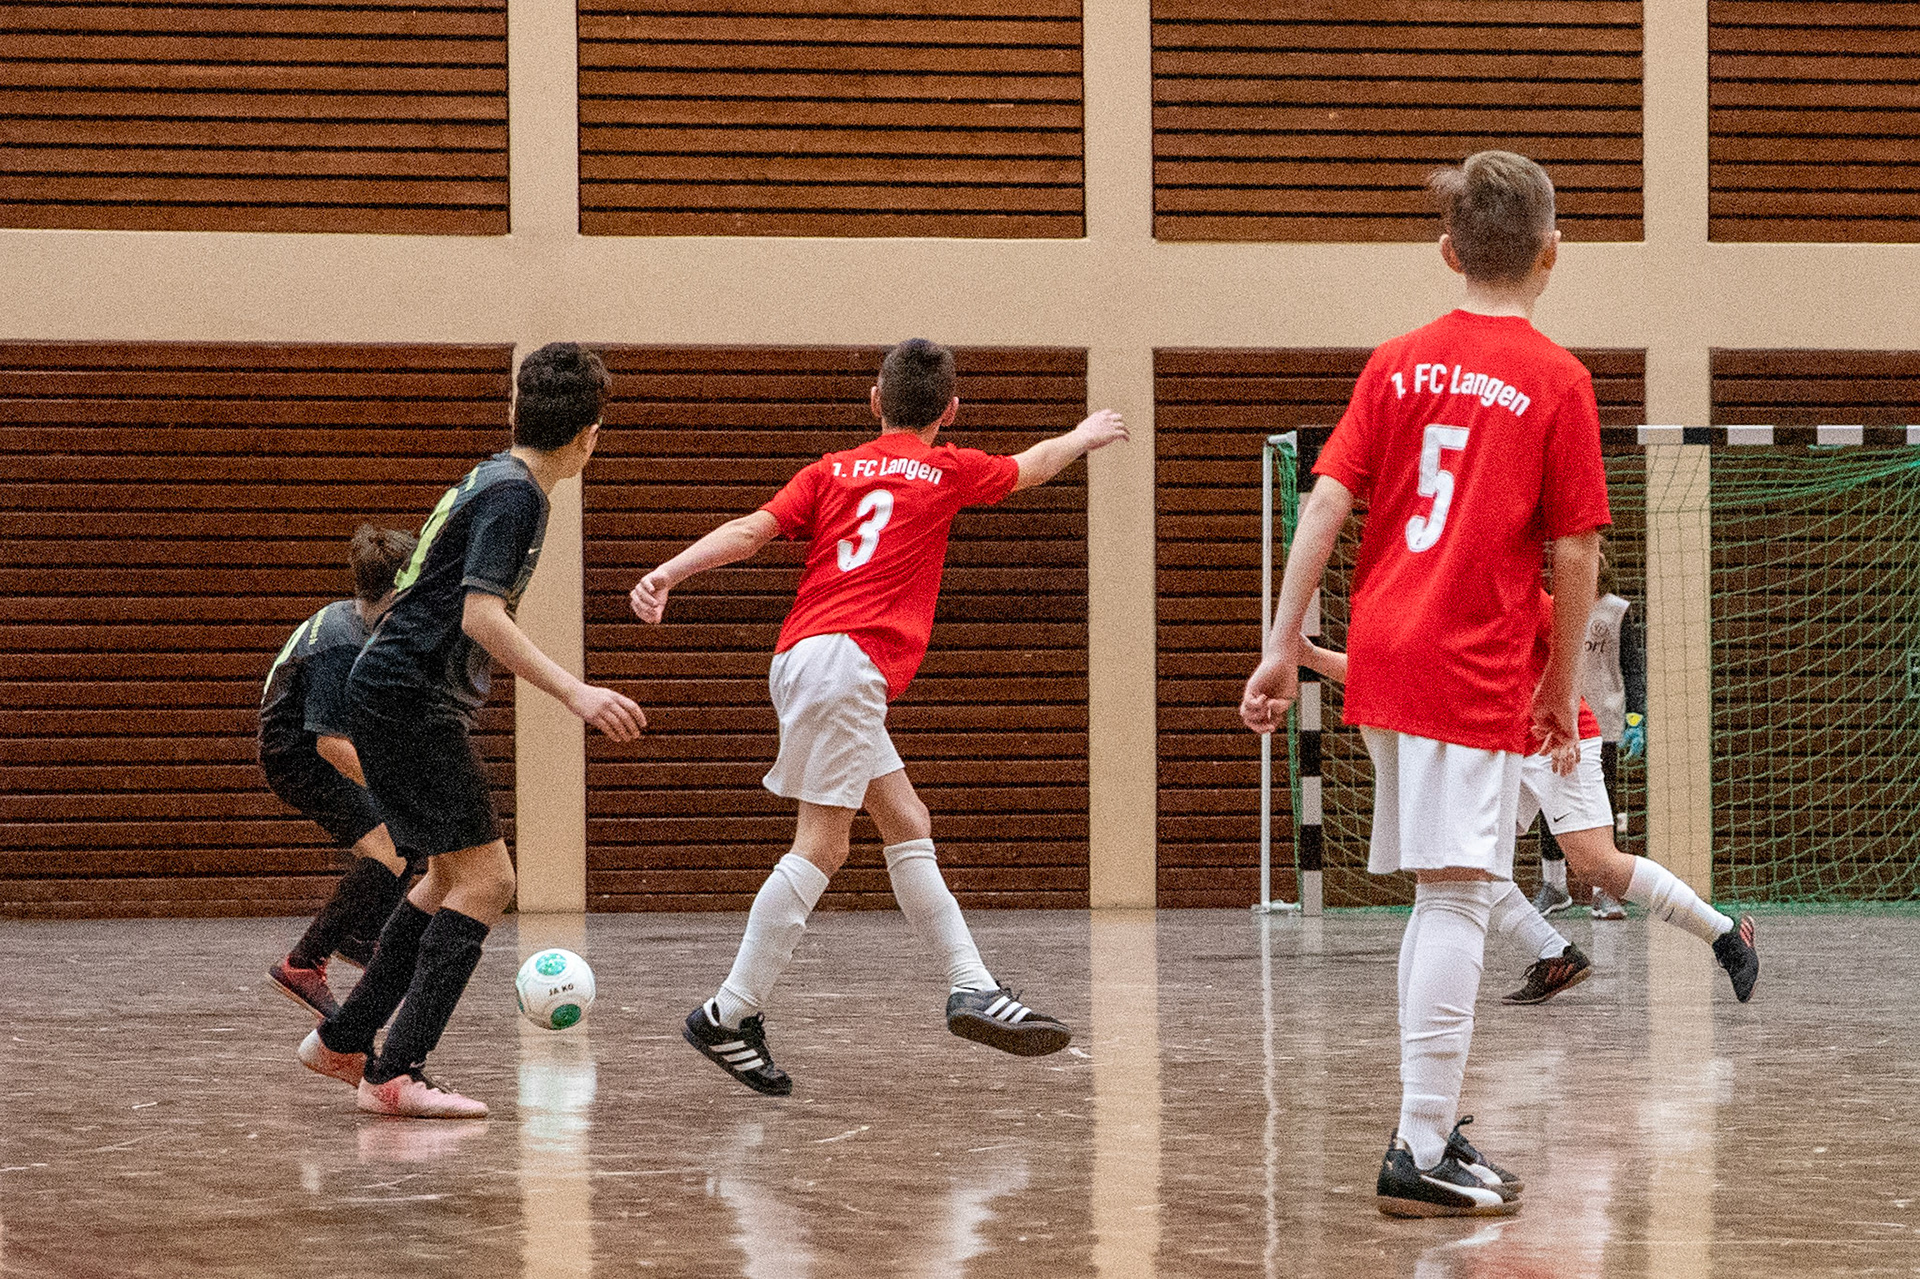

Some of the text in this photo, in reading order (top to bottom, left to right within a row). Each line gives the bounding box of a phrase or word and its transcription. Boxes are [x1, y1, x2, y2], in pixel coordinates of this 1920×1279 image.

[1414, 363, 1447, 394] FC
[1450, 364, 1531, 417] Langen
[833, 457, 943, 485] 1. FC Langen
[1405, 423, 1470, 553] 5
[837, 489, 894, 573] 3
